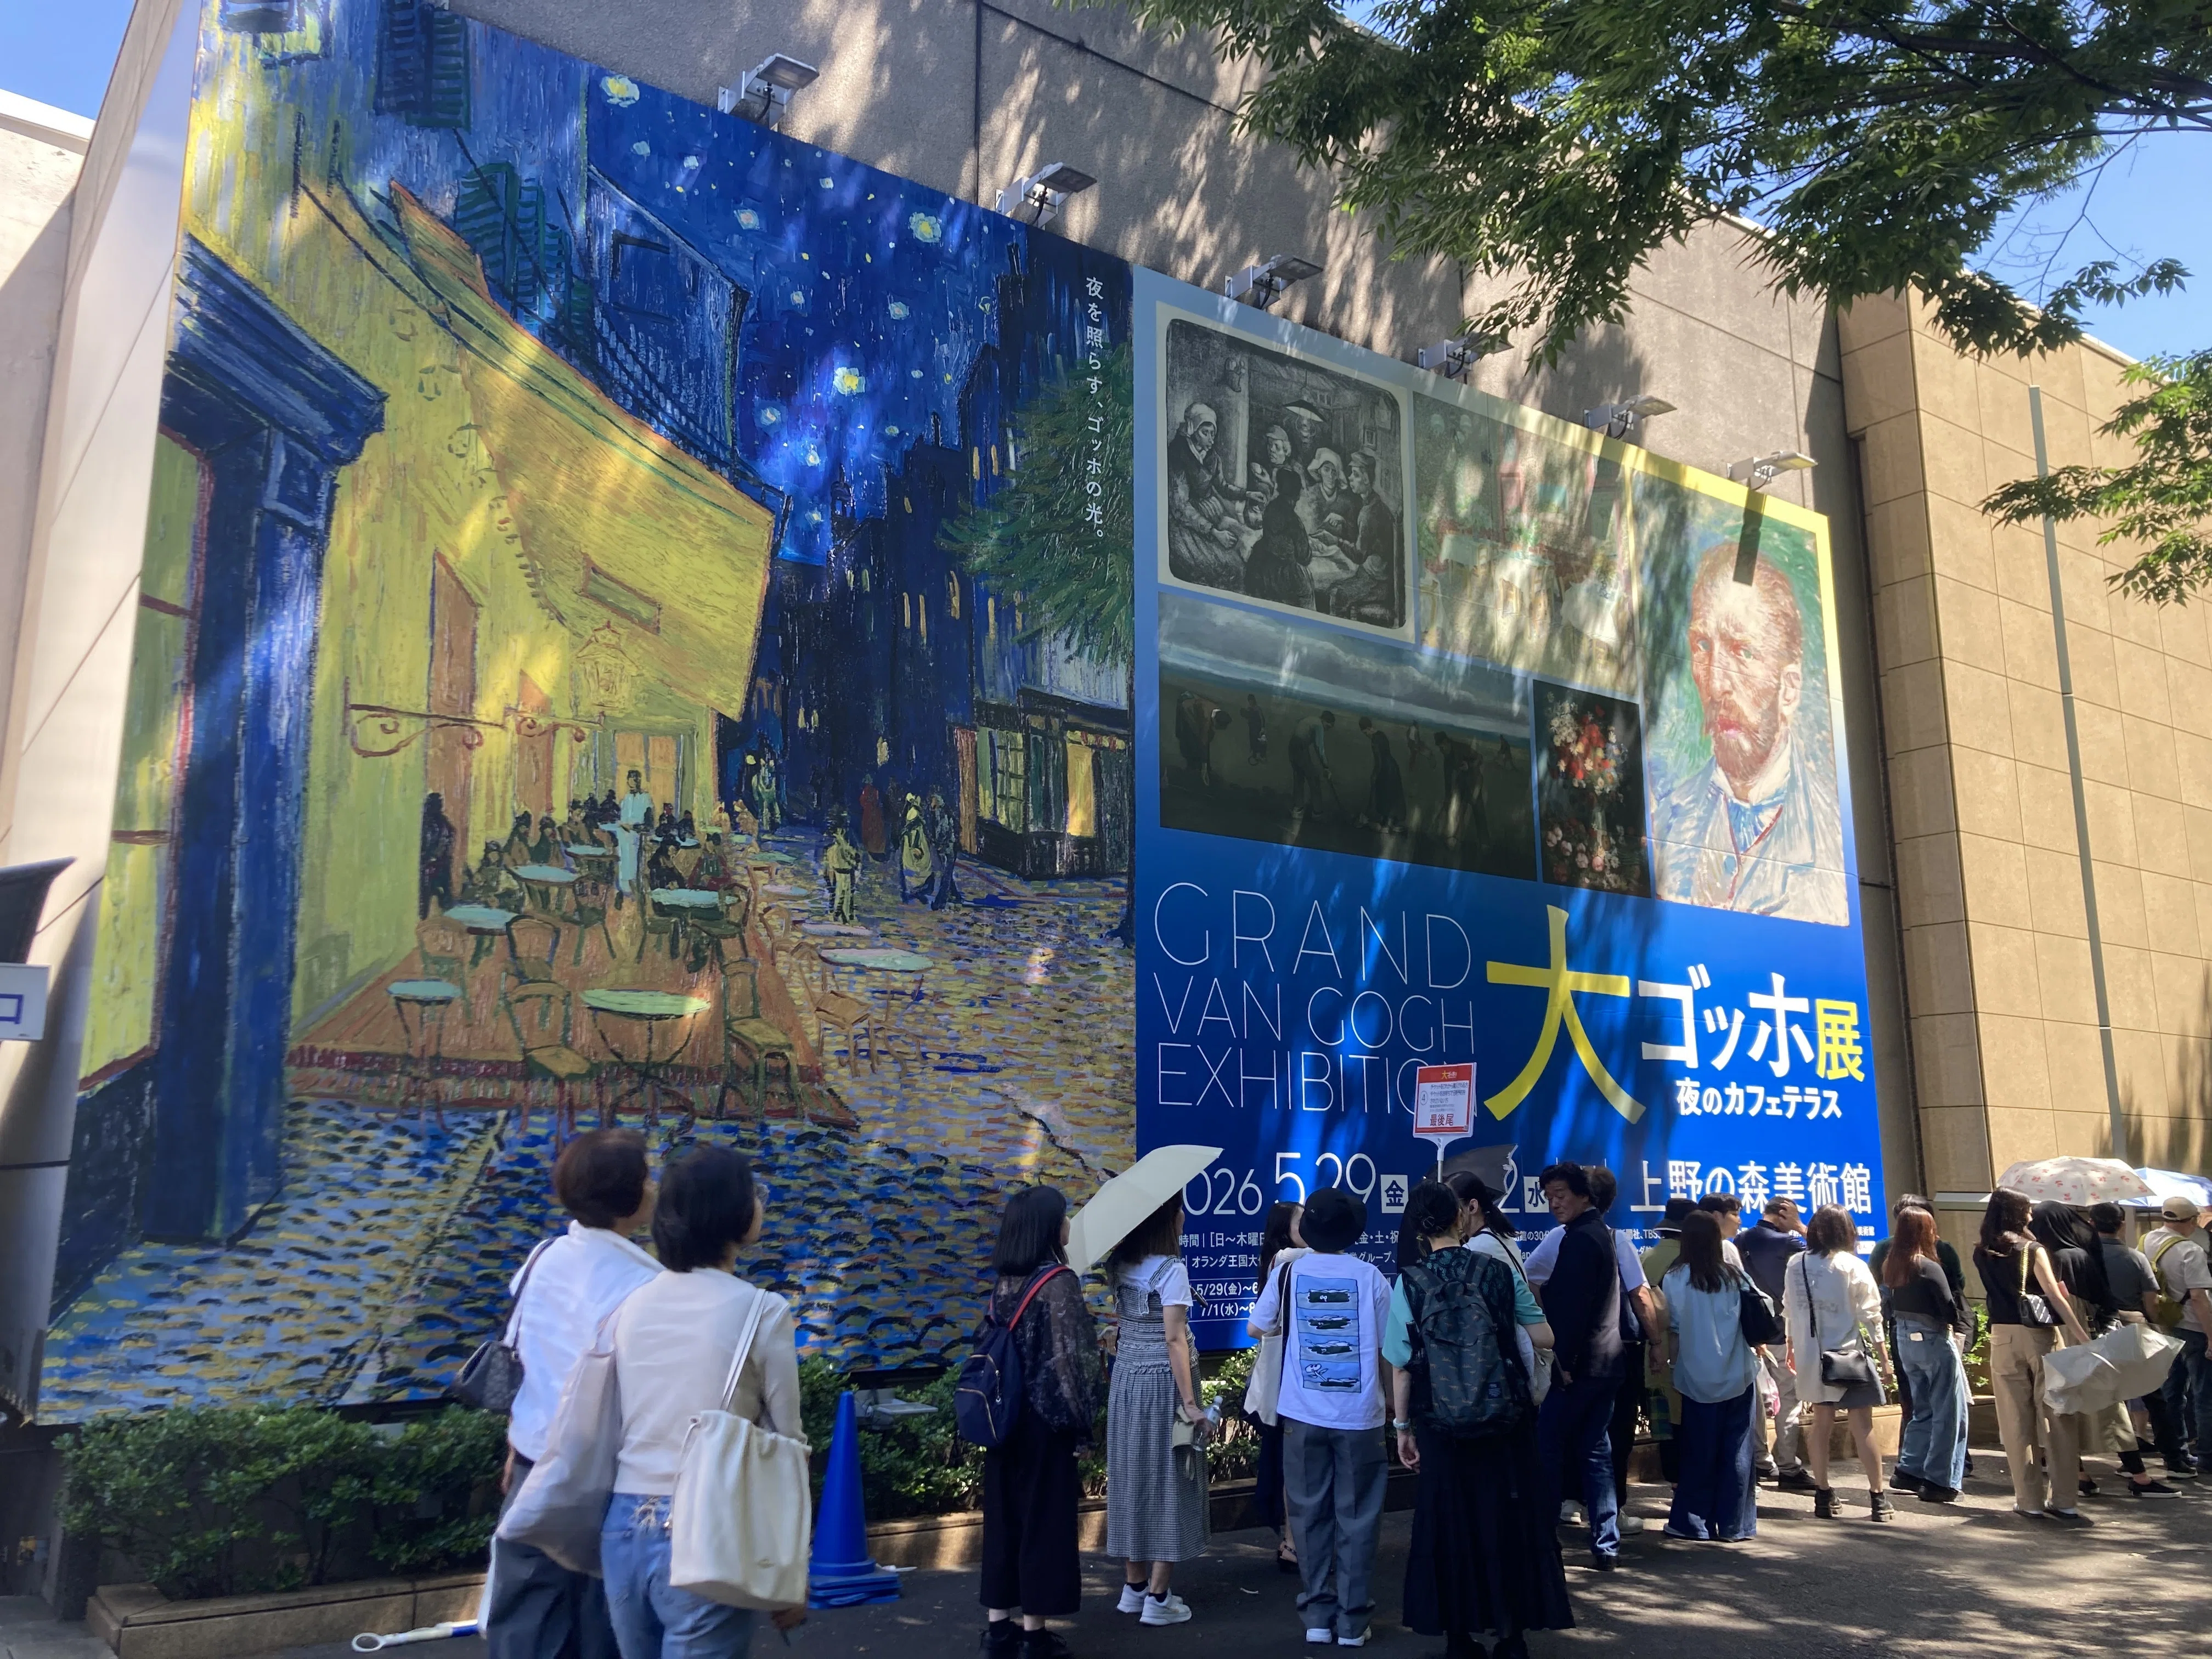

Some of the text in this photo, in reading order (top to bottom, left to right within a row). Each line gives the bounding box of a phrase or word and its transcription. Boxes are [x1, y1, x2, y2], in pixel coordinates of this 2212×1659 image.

[1086, 276, 1104, 538] 夜を照らす、ゴッホの光。
[1154, 882, 1471, 989] GRAND
[1154, 972, 1475, 1054] VAN GOGH
[1430, 1114, 1454, 1126] 最後尾
[1676, 1077, 1842, 1120] 夜のカフェテラス
[1182, 1168, 1262, 1215] 026
[1384, 1180, 1405, 1207] 金
[1630, 1160, 1872, 1215] 上野の森美術館
